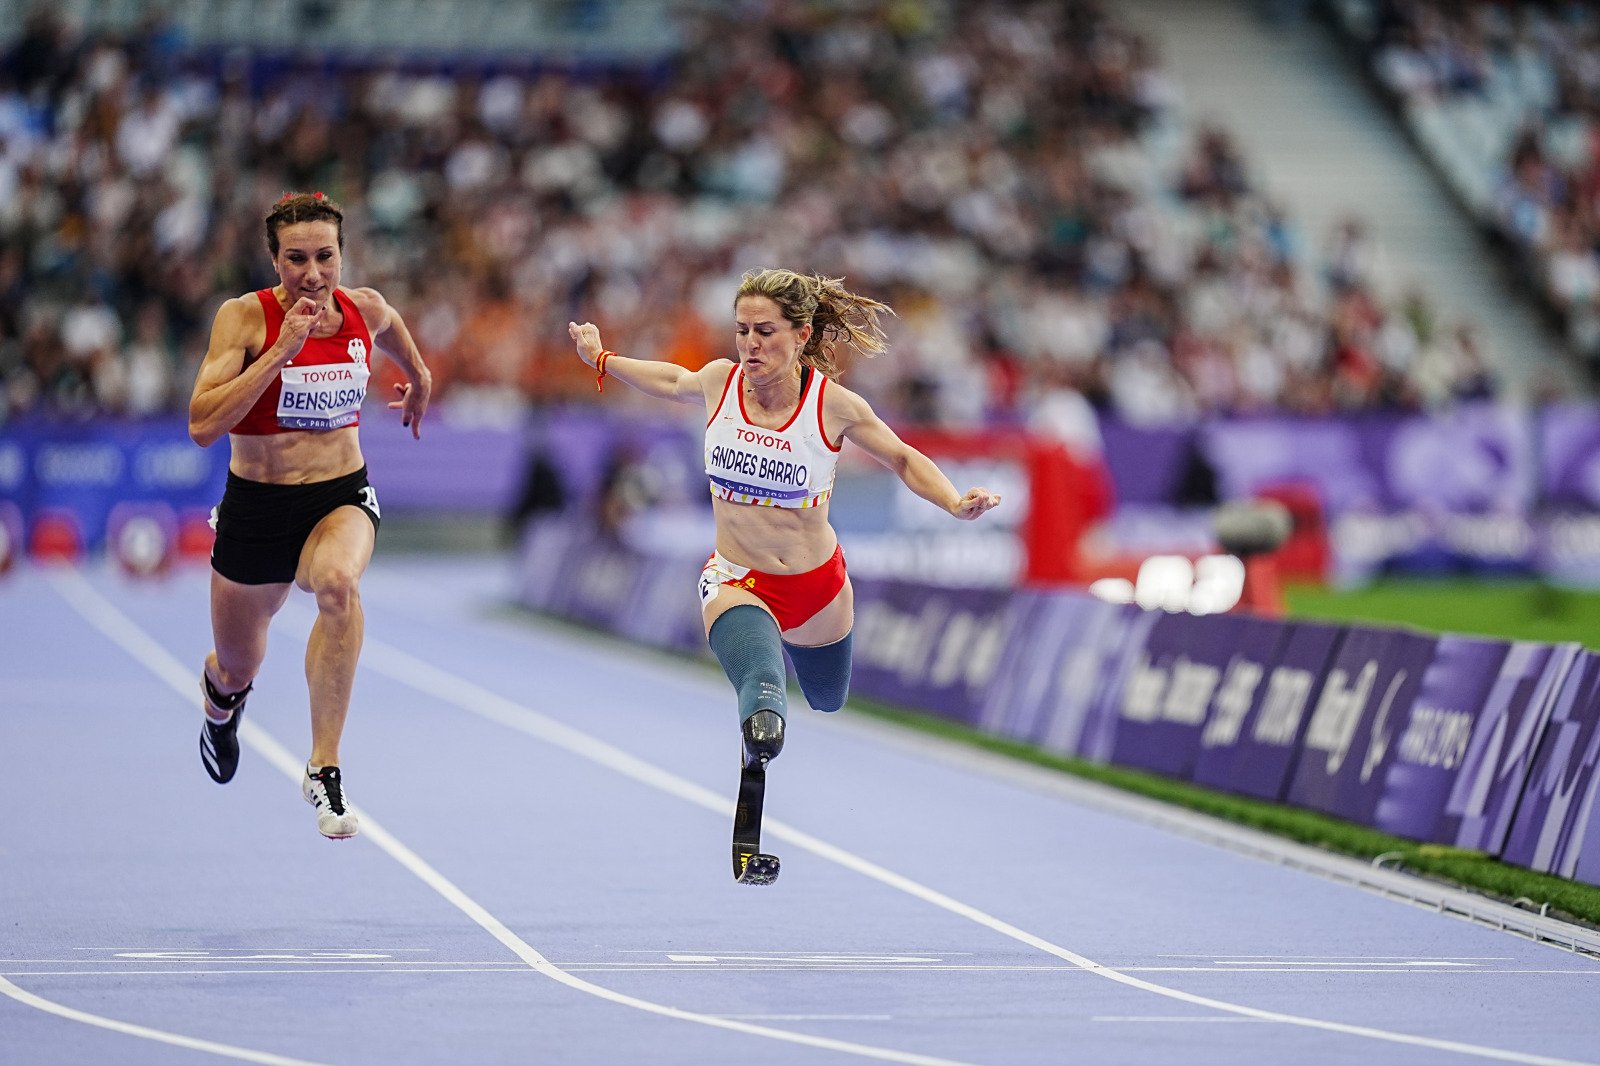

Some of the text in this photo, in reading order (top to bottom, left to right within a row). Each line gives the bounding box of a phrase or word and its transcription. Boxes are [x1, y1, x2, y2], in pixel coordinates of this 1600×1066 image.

[302, 370, 353, 383] TOYOTA
[283, 387, 364, 410] BENSUSAN
[737, 428, 792, 452] TOYOTA
[711, 445, 807, 487] ANDRES BARRIO
[738, 485, 763, 495] PARIS
